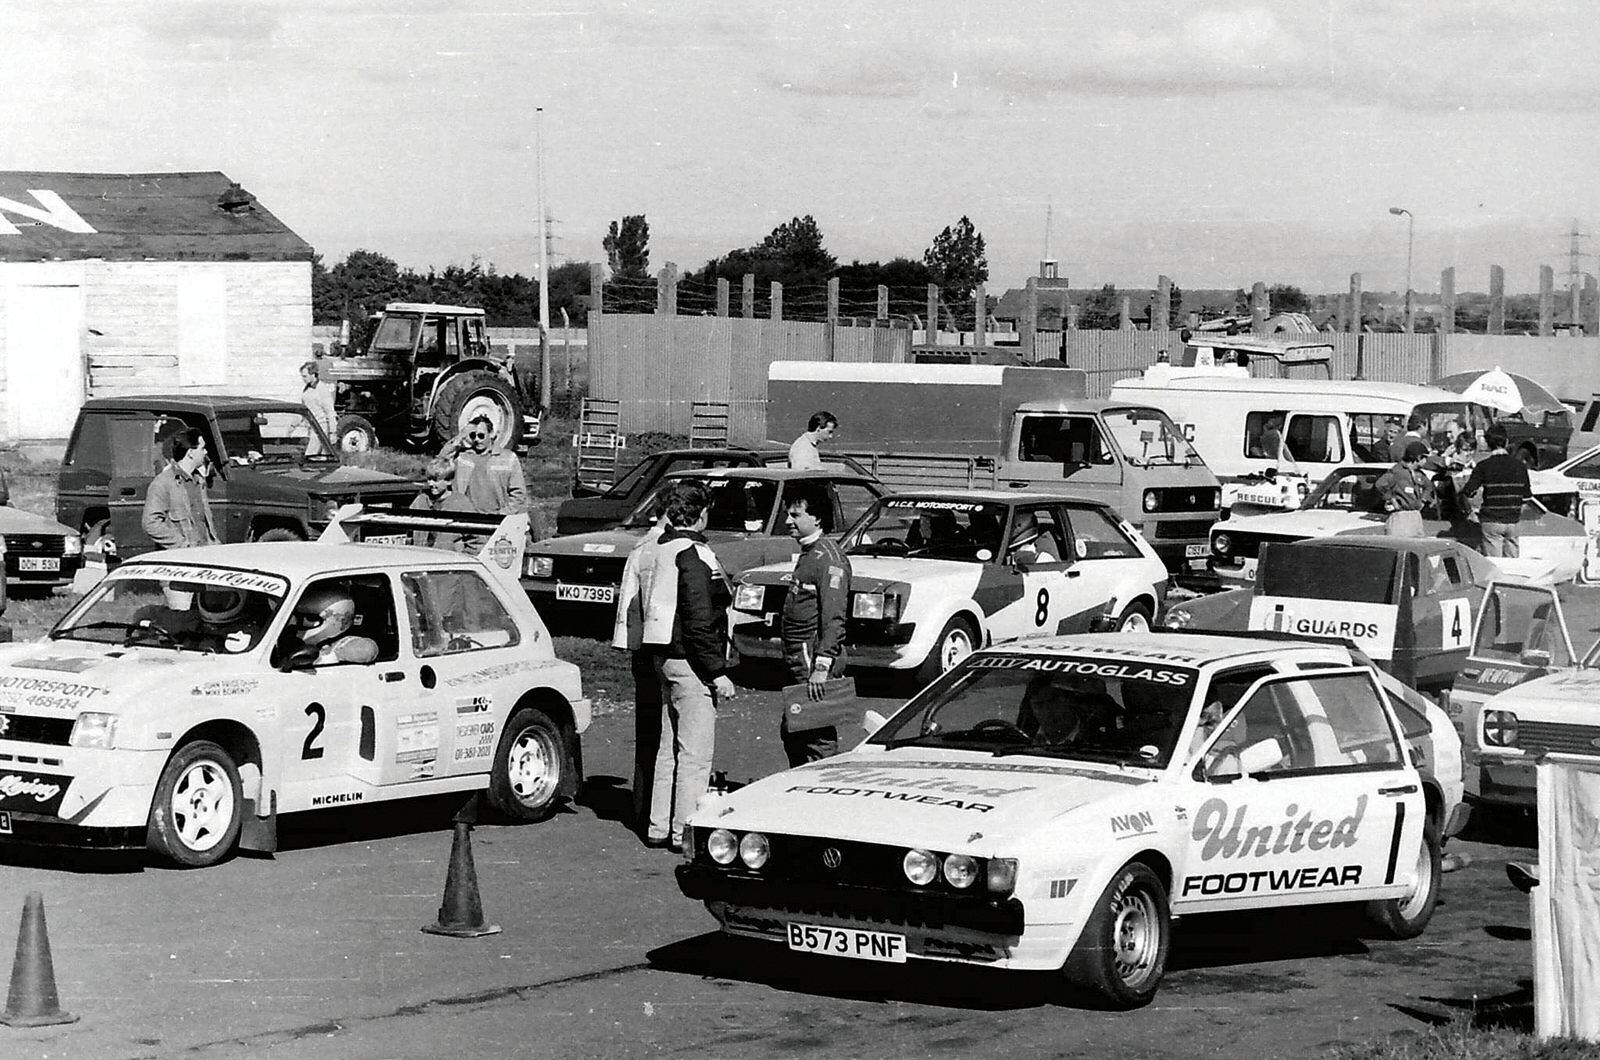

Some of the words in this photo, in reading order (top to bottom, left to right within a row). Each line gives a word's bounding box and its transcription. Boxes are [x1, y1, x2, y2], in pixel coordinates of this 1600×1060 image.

[1481, 384, 1508, 394] RAC
[915, 501, 975, 511] MOTORSPORT
[1236, 492, 1277, 504] RESCUE
[190, 569, 281, 592] Rallying
[582, 587, 612, 602] 739S
[1035, 587, 1050, 627] 8
[1297, 618, 1379, 639] GUARDS
[1452, 605, 1462, 646] 4
[1021, 658, 1190, 686] AUTOGLASS
[301, 702, 326, 760] 2
[312, 792, 363, 805] MICHELIN
[785, 785, 996, 814] FOOTWEAR
[1110, 811, 1154, 833] AVON
[1191, 793, 1369, 863] United
[1181, 865, 1363, 897] FOOTWEAR
[790, 923, 848, 953] B573
[855, 933, 902, 958] PNF
